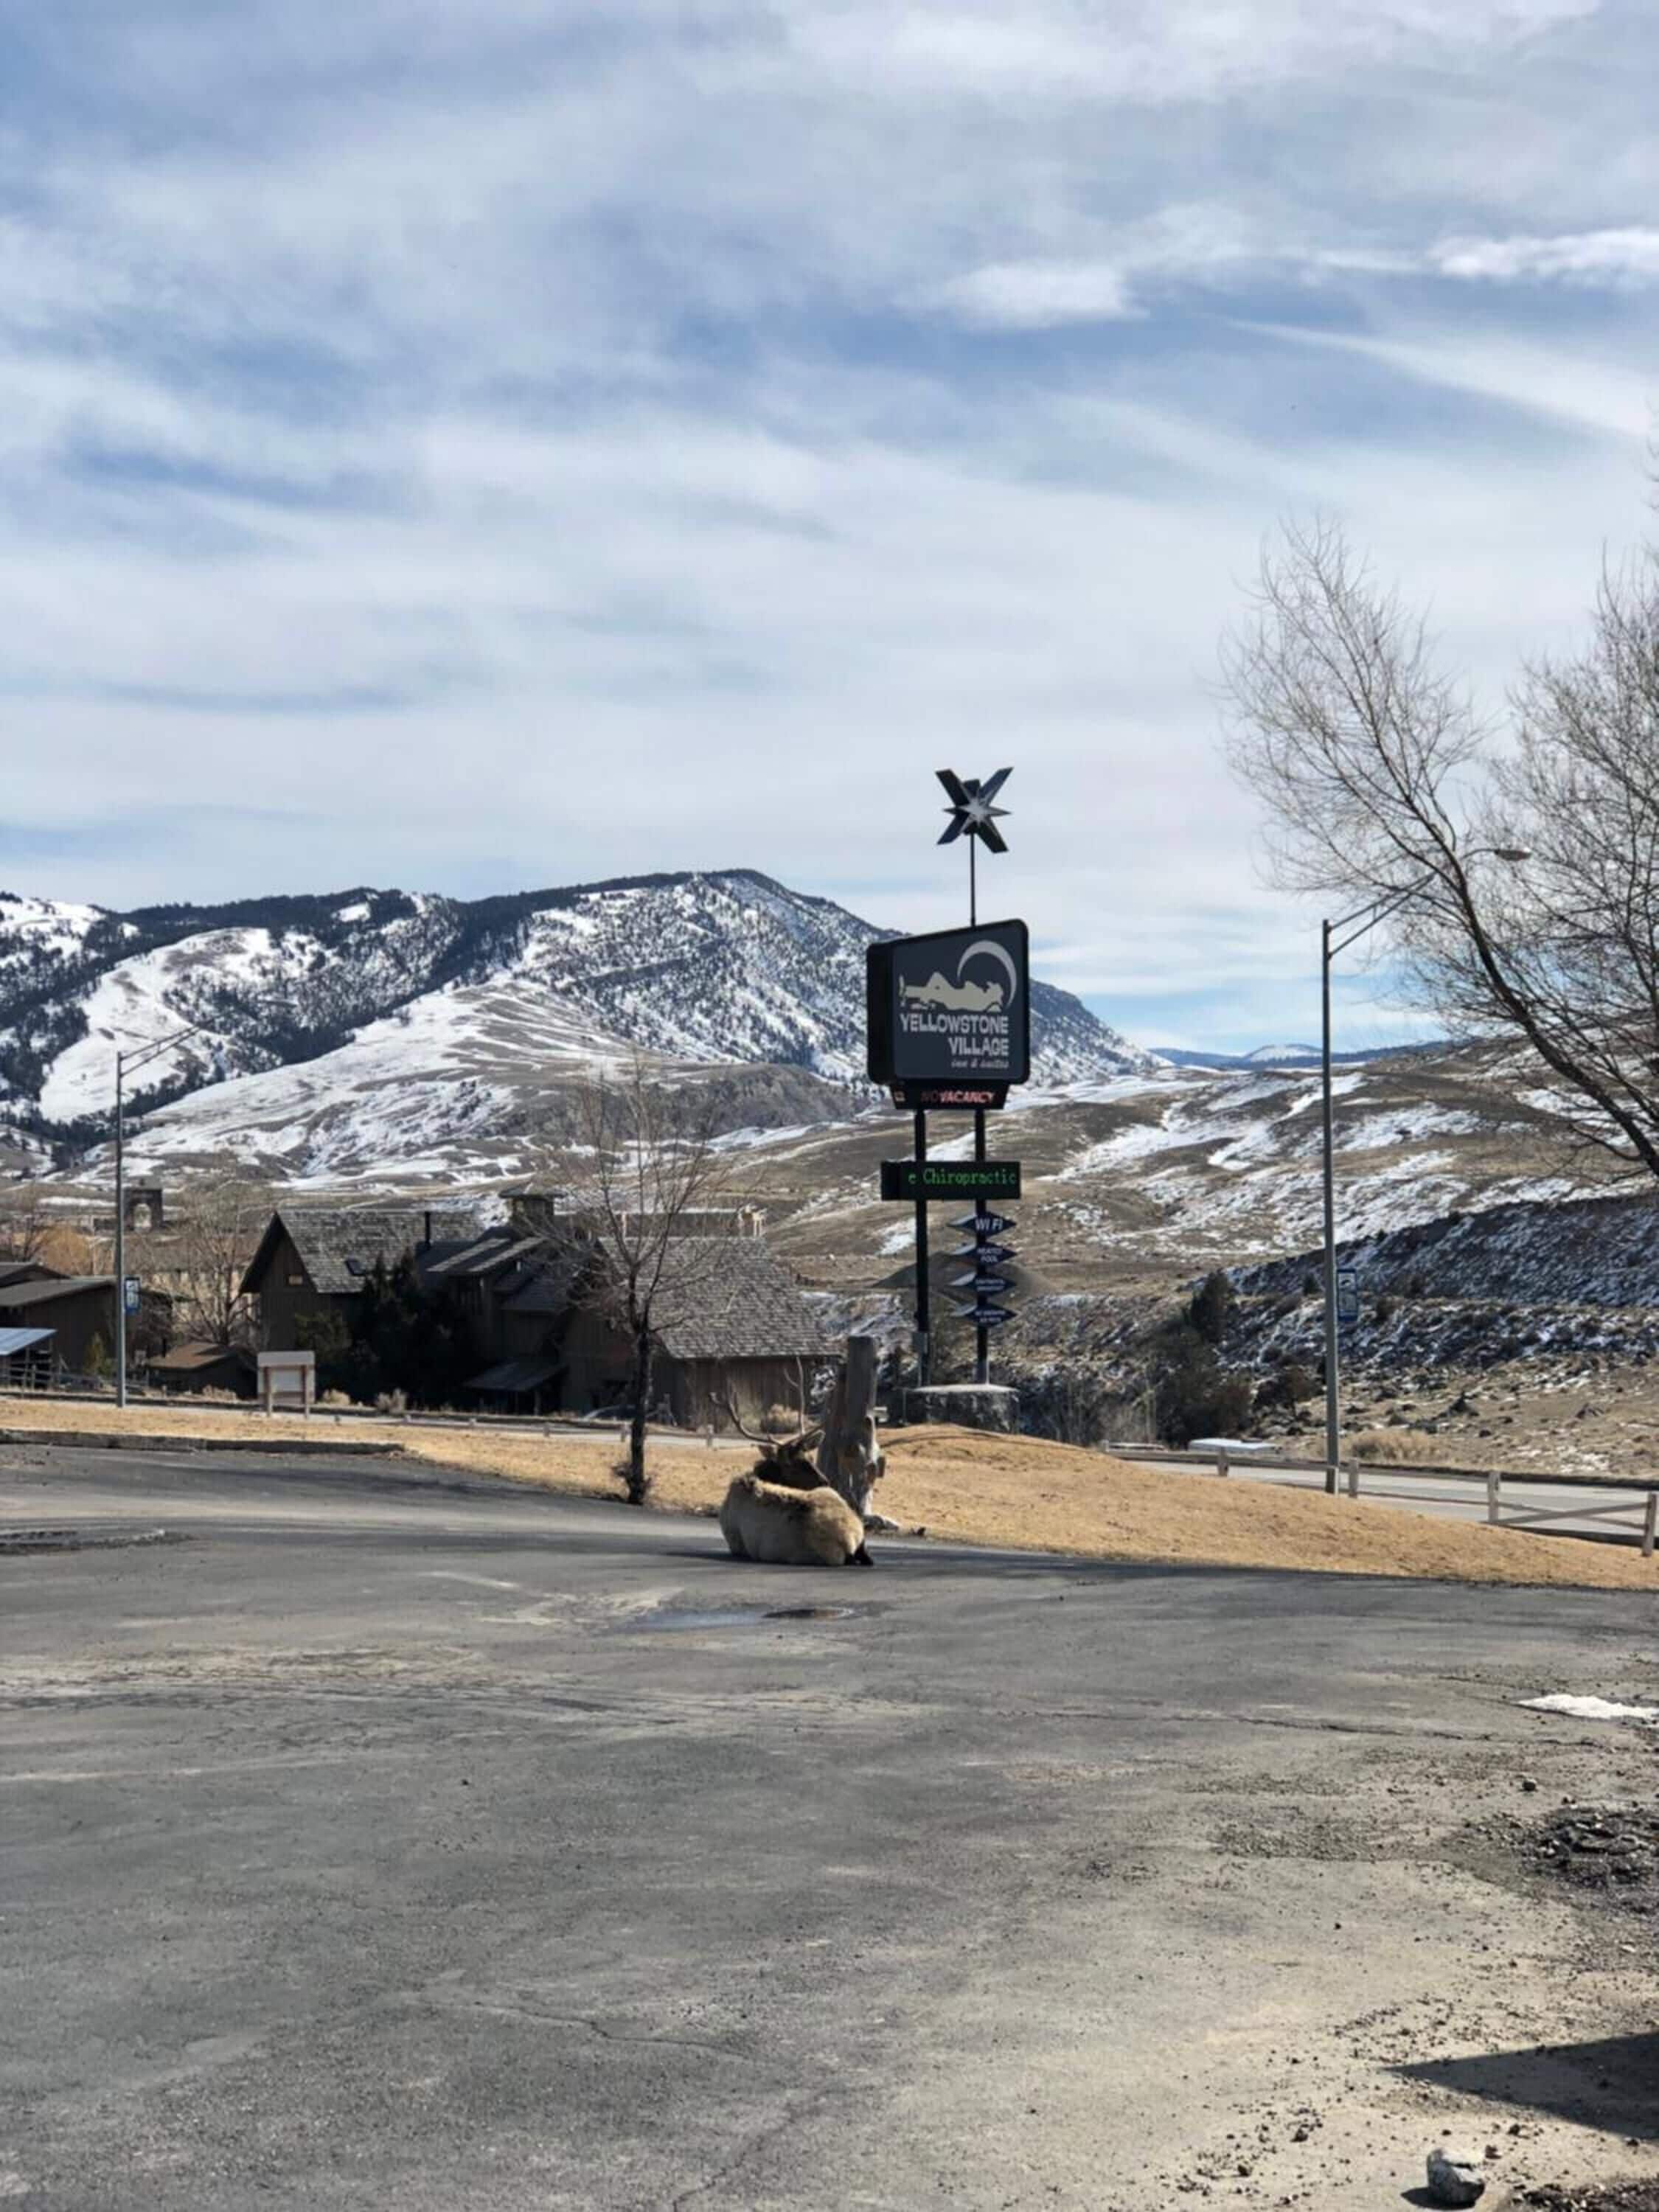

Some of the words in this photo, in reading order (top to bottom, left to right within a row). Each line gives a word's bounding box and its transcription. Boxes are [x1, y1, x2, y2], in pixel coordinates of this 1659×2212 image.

[900, 1013, 1009, 1034] YELLOWSTONE
[948, 1036, 1009, 1056] VILLAGE
[940, 1090, 995, 1104] VACANCY
[923, 1167, 1015, 1186] Chiropractic
